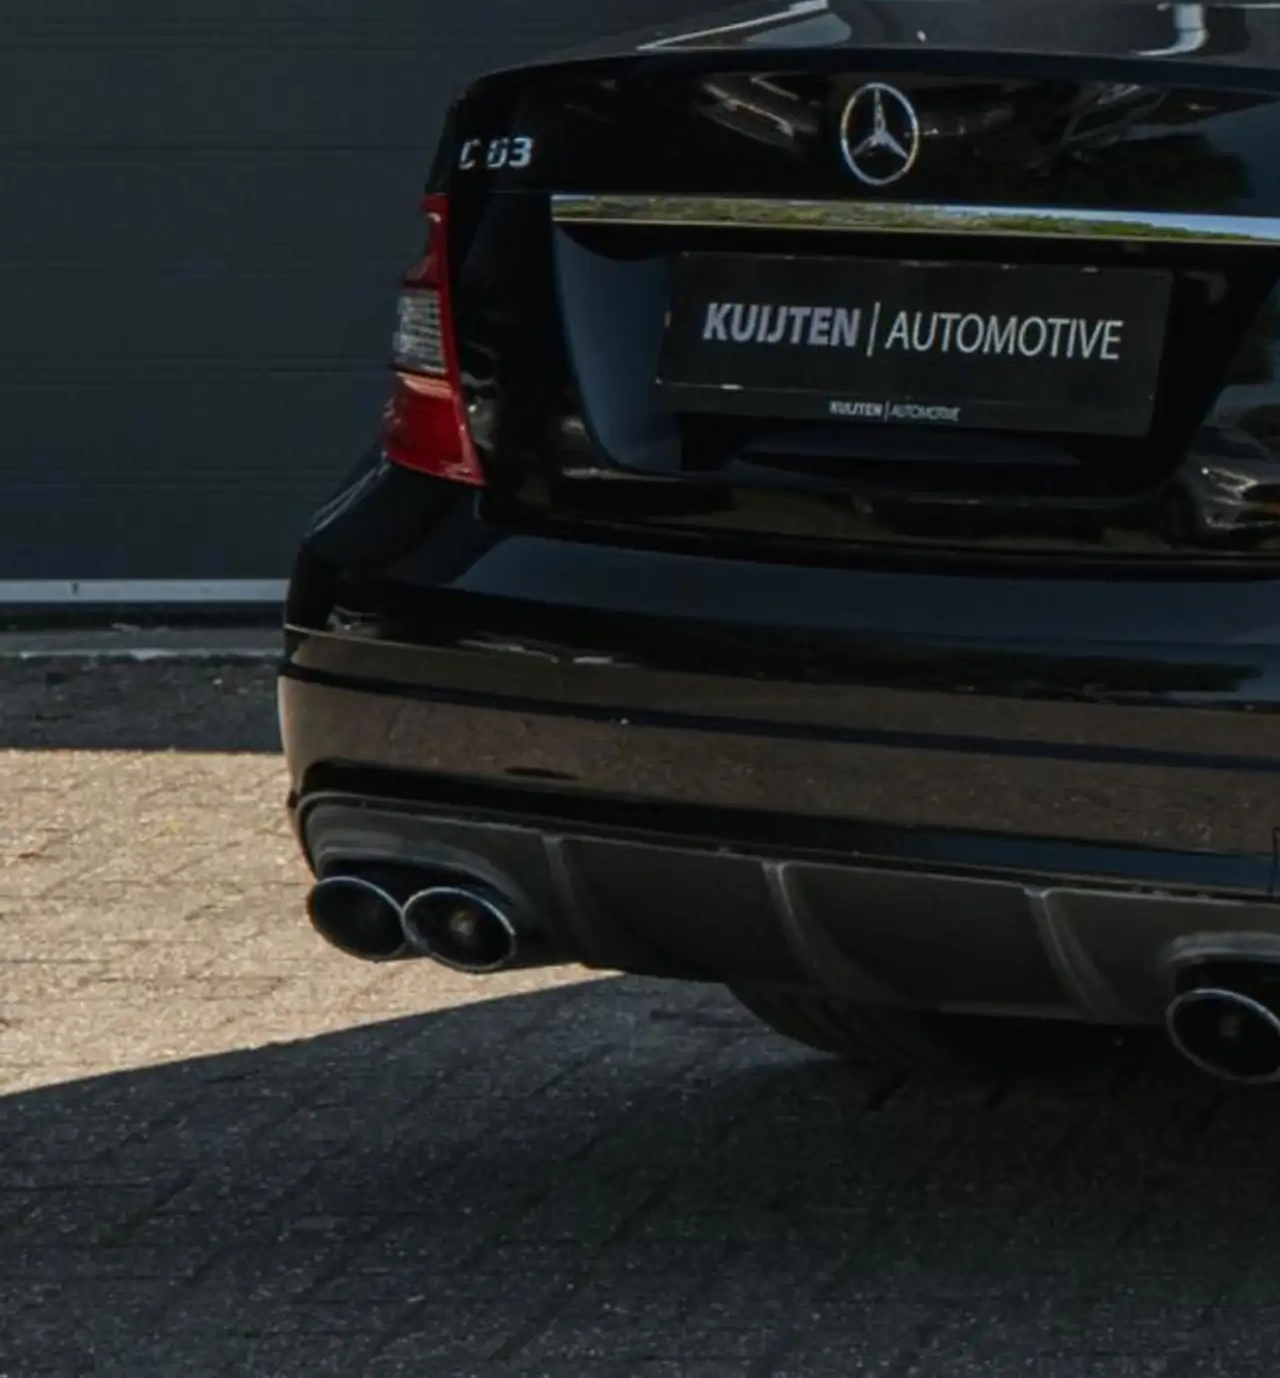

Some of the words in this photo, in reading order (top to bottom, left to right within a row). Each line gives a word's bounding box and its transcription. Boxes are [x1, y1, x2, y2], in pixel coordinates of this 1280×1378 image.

[460, 139, 481, 170] C
[702, 303, 861, 347] KUIJTEN
[884, 311, 1124, 361] AUTOMOTIVE
